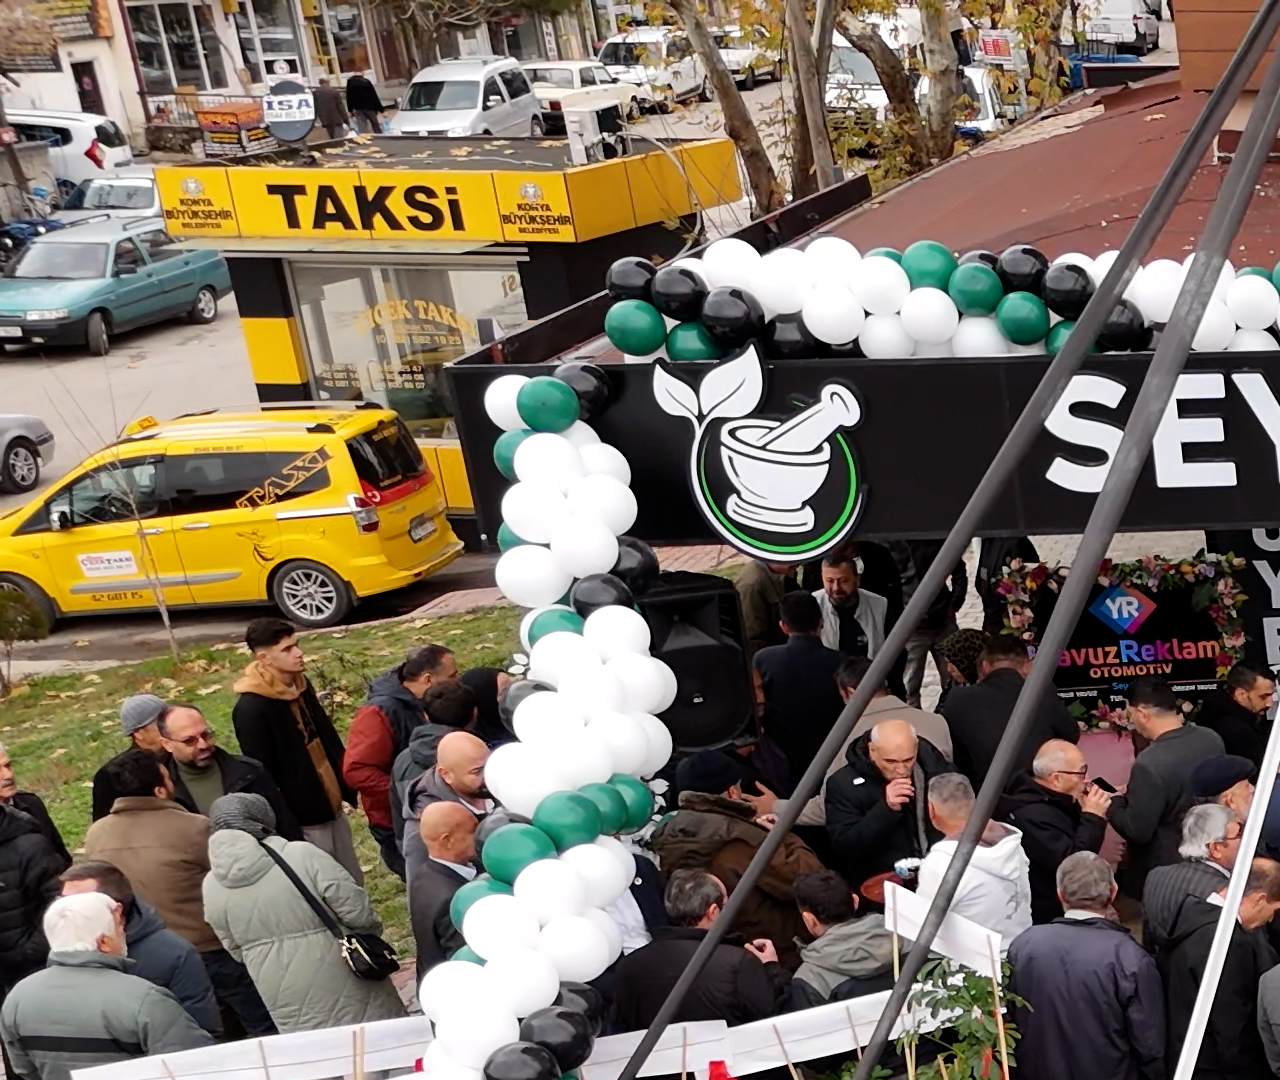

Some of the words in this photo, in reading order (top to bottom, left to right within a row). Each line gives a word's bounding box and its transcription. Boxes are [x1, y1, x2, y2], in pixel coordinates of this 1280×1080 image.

[179, 197, 214, 208] KONYA
[517, 202, 551, 212] KONYA
[165, 208, 234, 223] BÜYÜKŞEHİR
[502, 212, 571, 227] BÜYÜKŞEHİR
[235, 444, 334, 511] TAXI
[1105, 596, 1140, 619] YR
